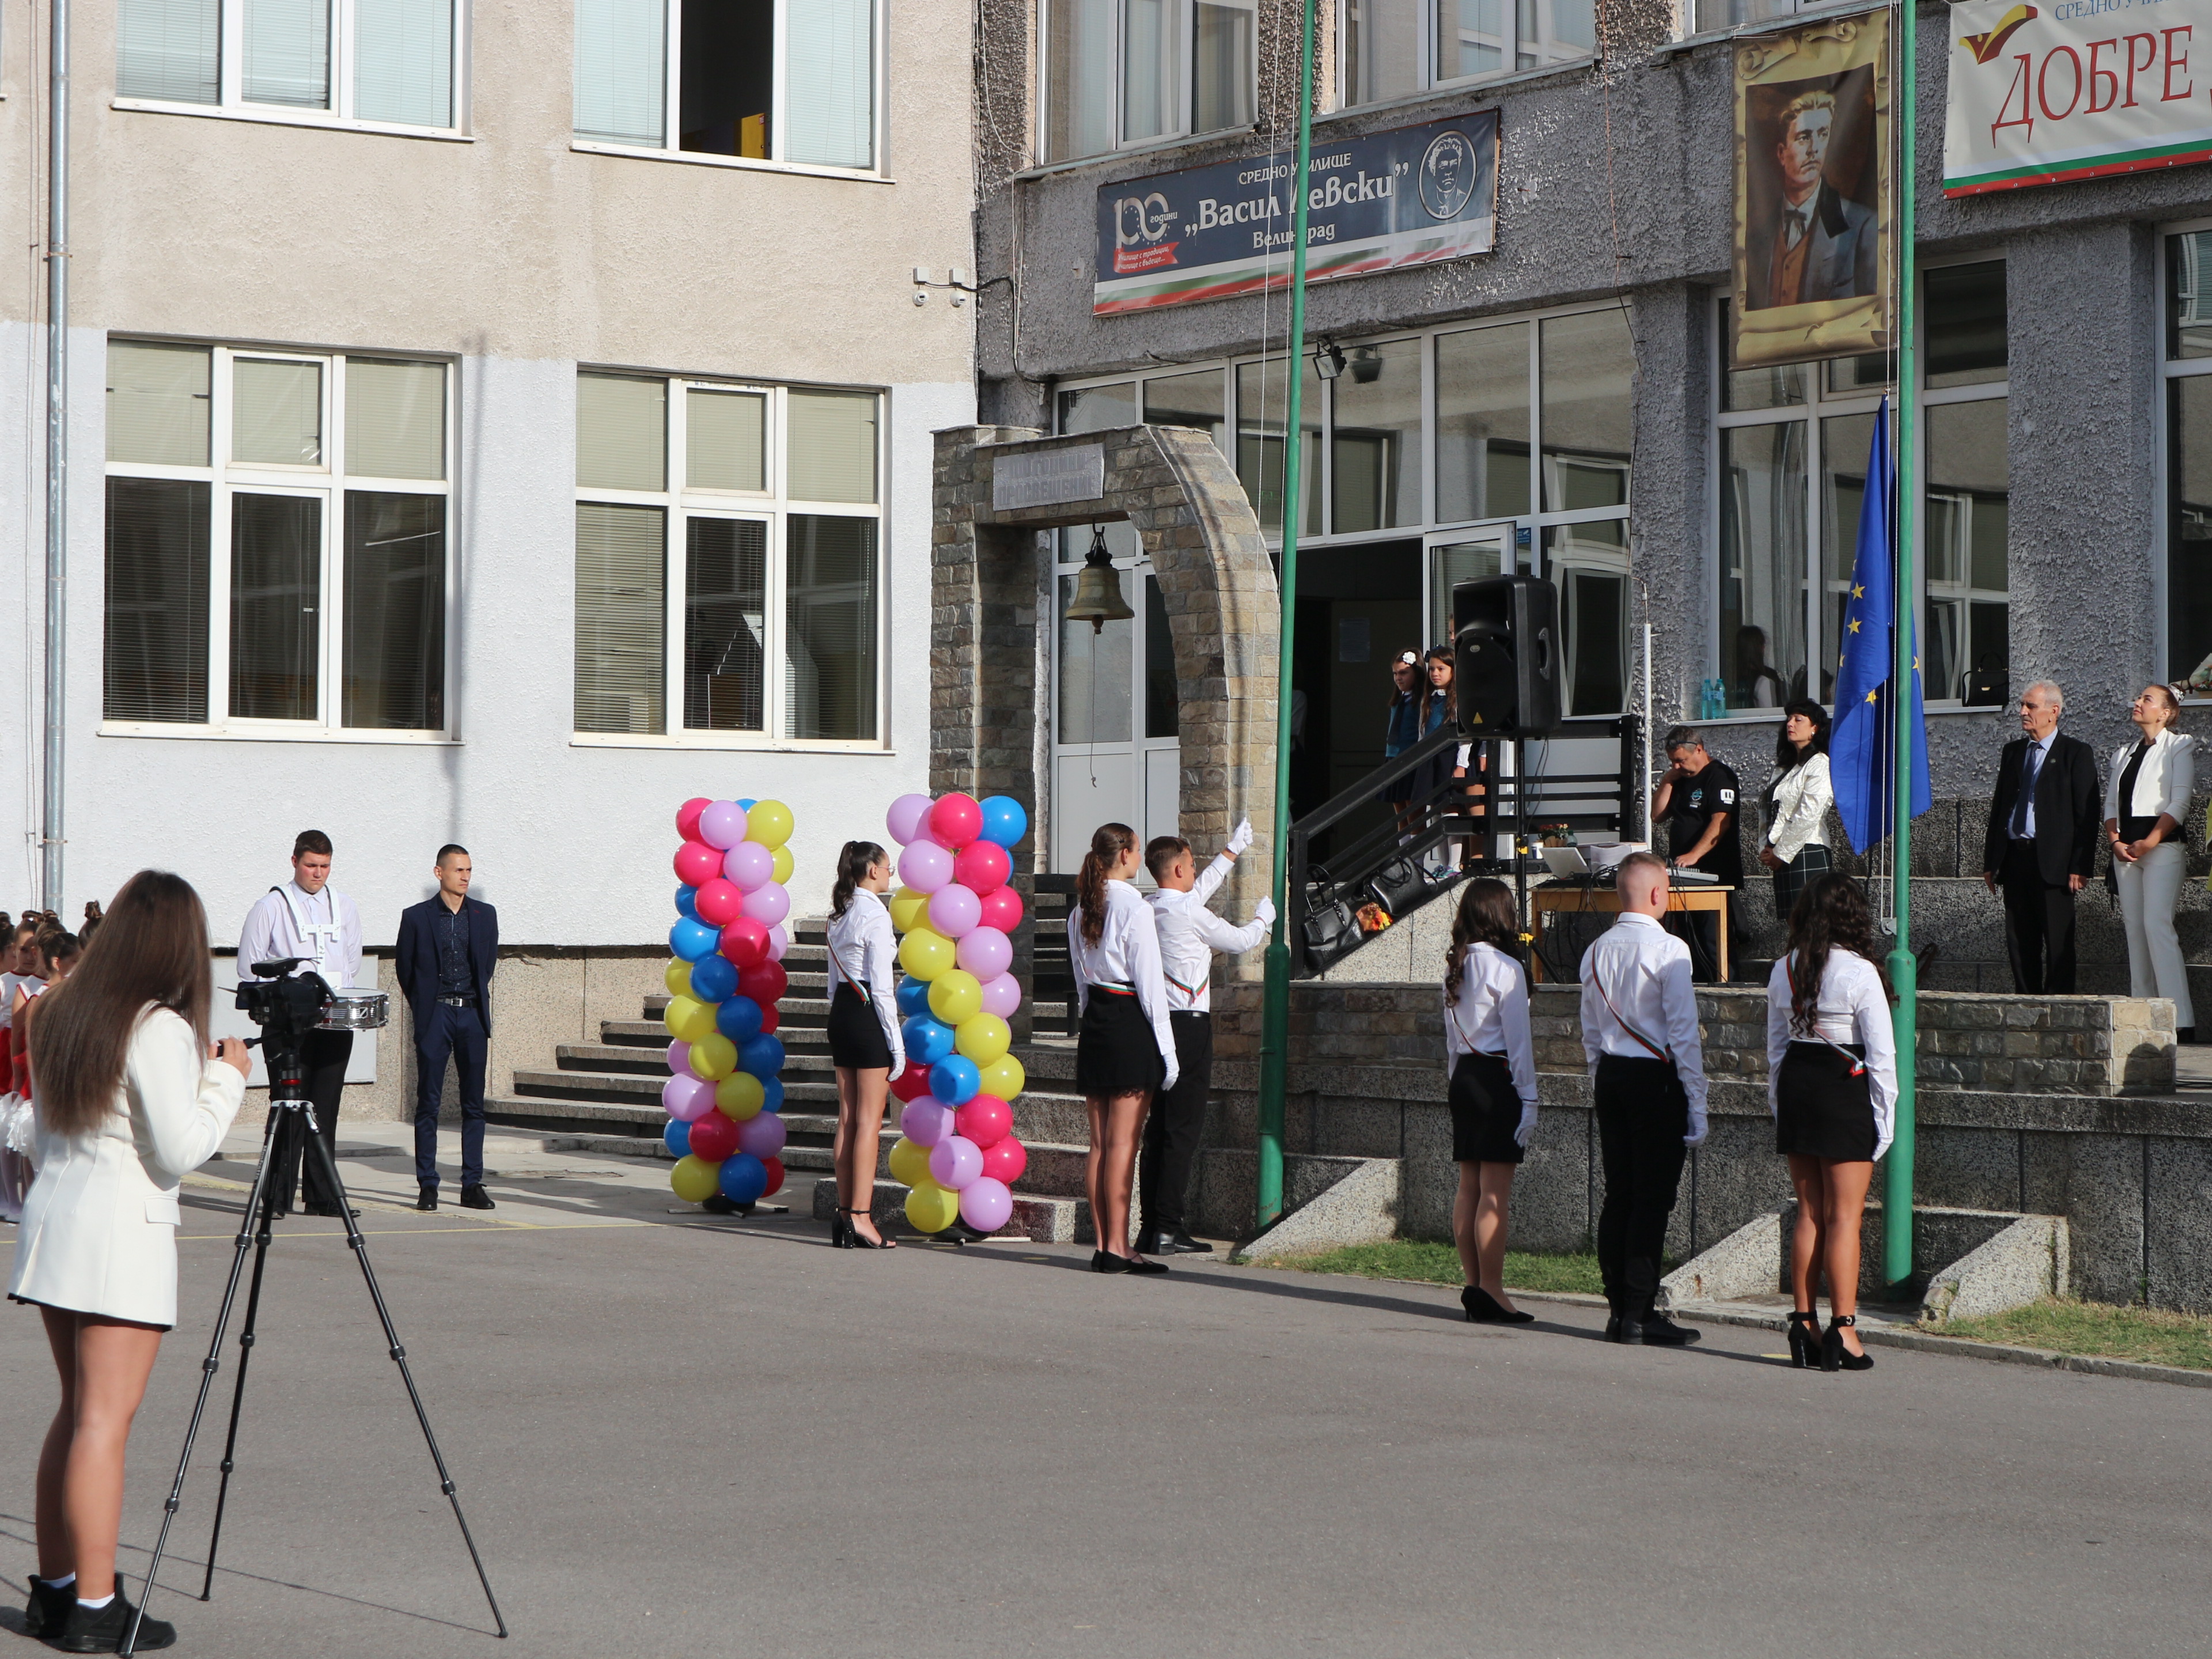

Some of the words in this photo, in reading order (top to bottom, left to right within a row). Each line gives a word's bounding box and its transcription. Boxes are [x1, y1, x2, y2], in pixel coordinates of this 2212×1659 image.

[1991, 25, 2193, 149] ДОБРЕ
[1238, 164, 1288, 185] СРЕДНО
[1290, 153, 1351, 176] УИЛИЩЕ
[1150, 211, 1178, 224] години
[1253, 224, 1335, 249] Велинрад
